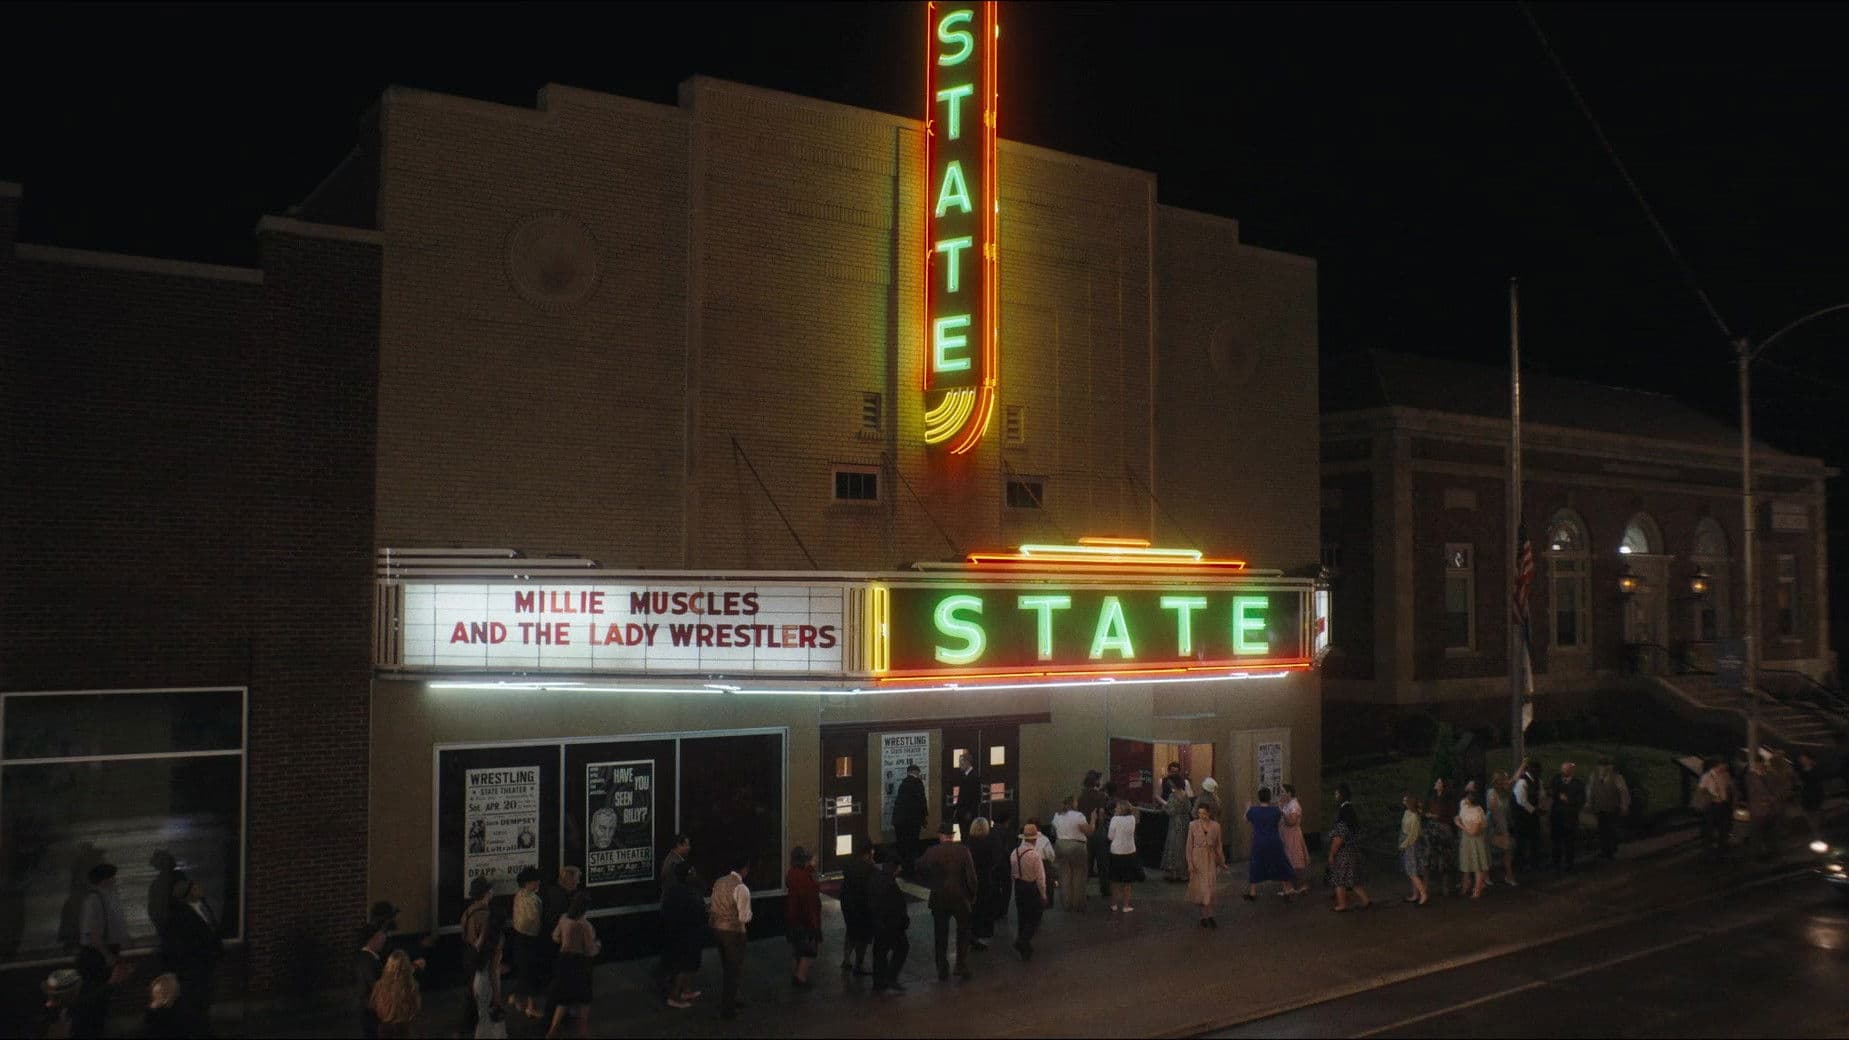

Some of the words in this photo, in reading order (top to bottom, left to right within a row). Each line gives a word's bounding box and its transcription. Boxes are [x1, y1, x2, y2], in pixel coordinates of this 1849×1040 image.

[933, 9, 974, 373] STATE
[514, 590, 605, 614] MILLIE
[630, 591, 760, 616] MUSCLES
[450, 621, 507, 644] AND
[518, 622, 570, 645] THE
[588, 622, 656, 647] LADY
[670, 623, 837, 649] WRESTLERS
[933, 594, 1269, 665] STATE
[885, 736, 927, 746] WRESTLING
[470, 770, 536, 785] WRESTLING
[613, 767, 633, 783] HAVE
[634, 775, 650, 790] YOU
[500, 786, 527, 794] THEATER
[614, 791, 633, 807] SEEN
[590, 852, 613, 866] STATE
[617, 847, 650, 860] THEATER
